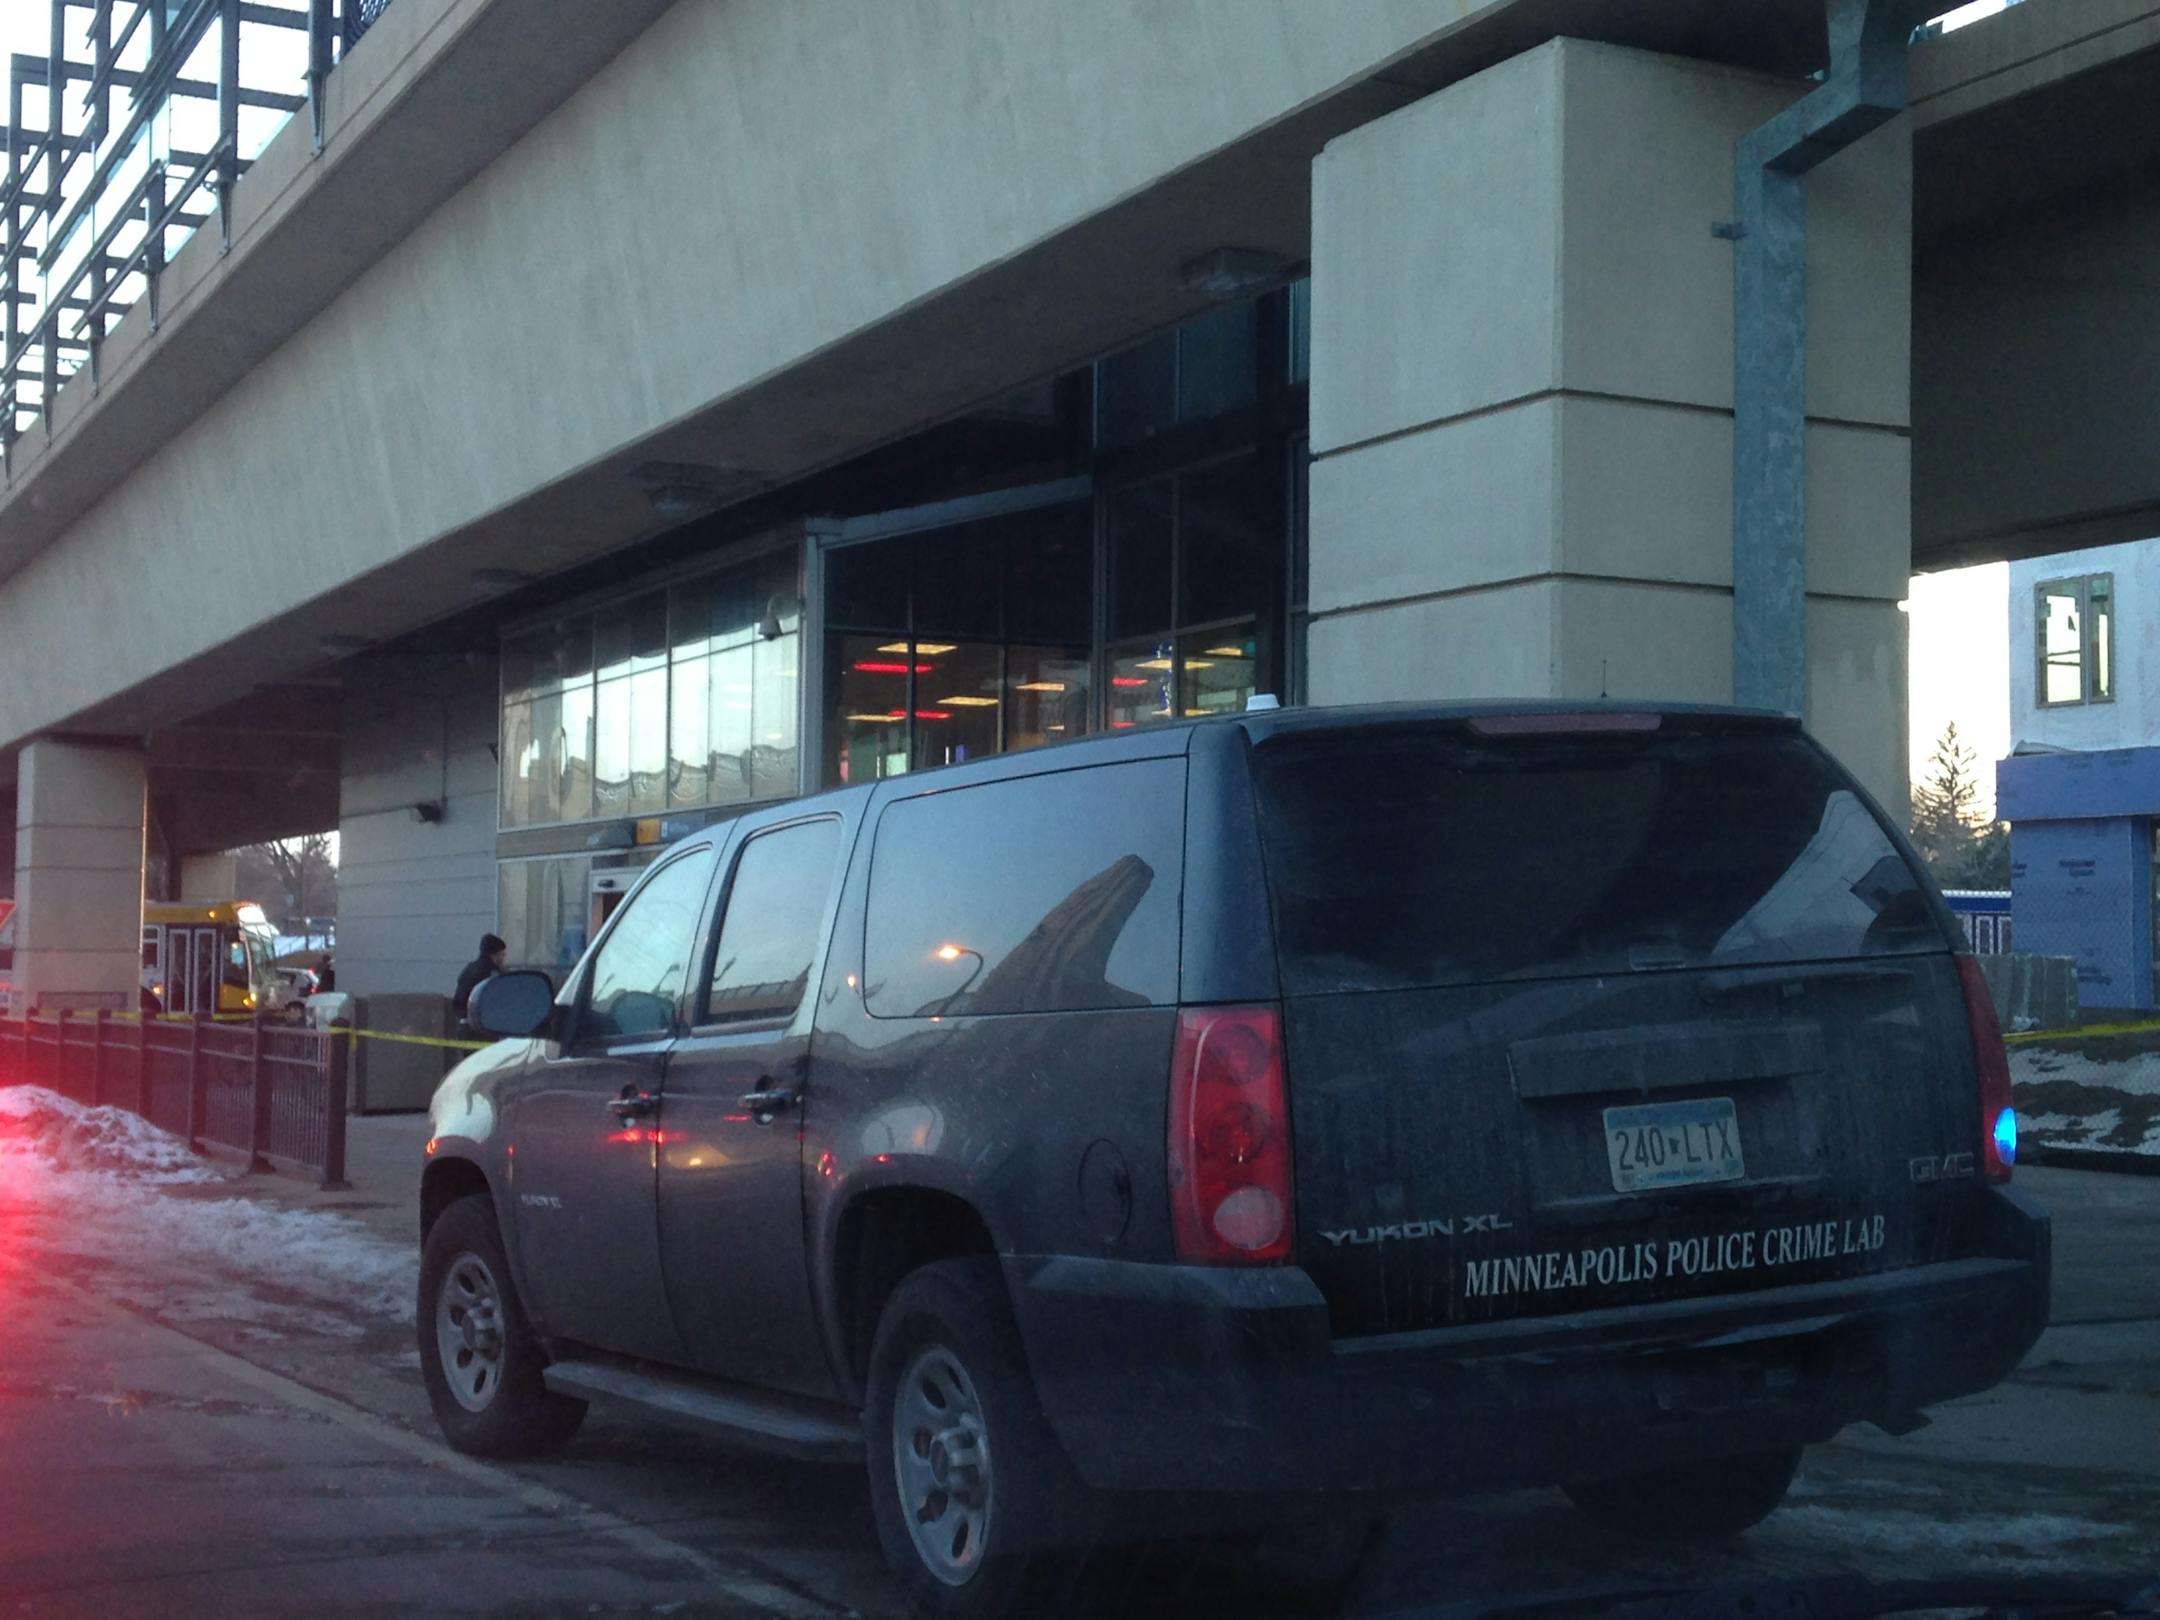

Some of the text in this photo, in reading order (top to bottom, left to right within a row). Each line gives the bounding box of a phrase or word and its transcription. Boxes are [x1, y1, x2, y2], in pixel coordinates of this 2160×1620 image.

[1615, 1120, 1734, 1171] 240 LTX
[1909, 1152, 1974, 1184] GMC
[1322, 1213, 1513, 1247] YUKON XL
[1464, 1214, 1886, 1298] MINNEAPOLIS POLICE CRIME LAB
